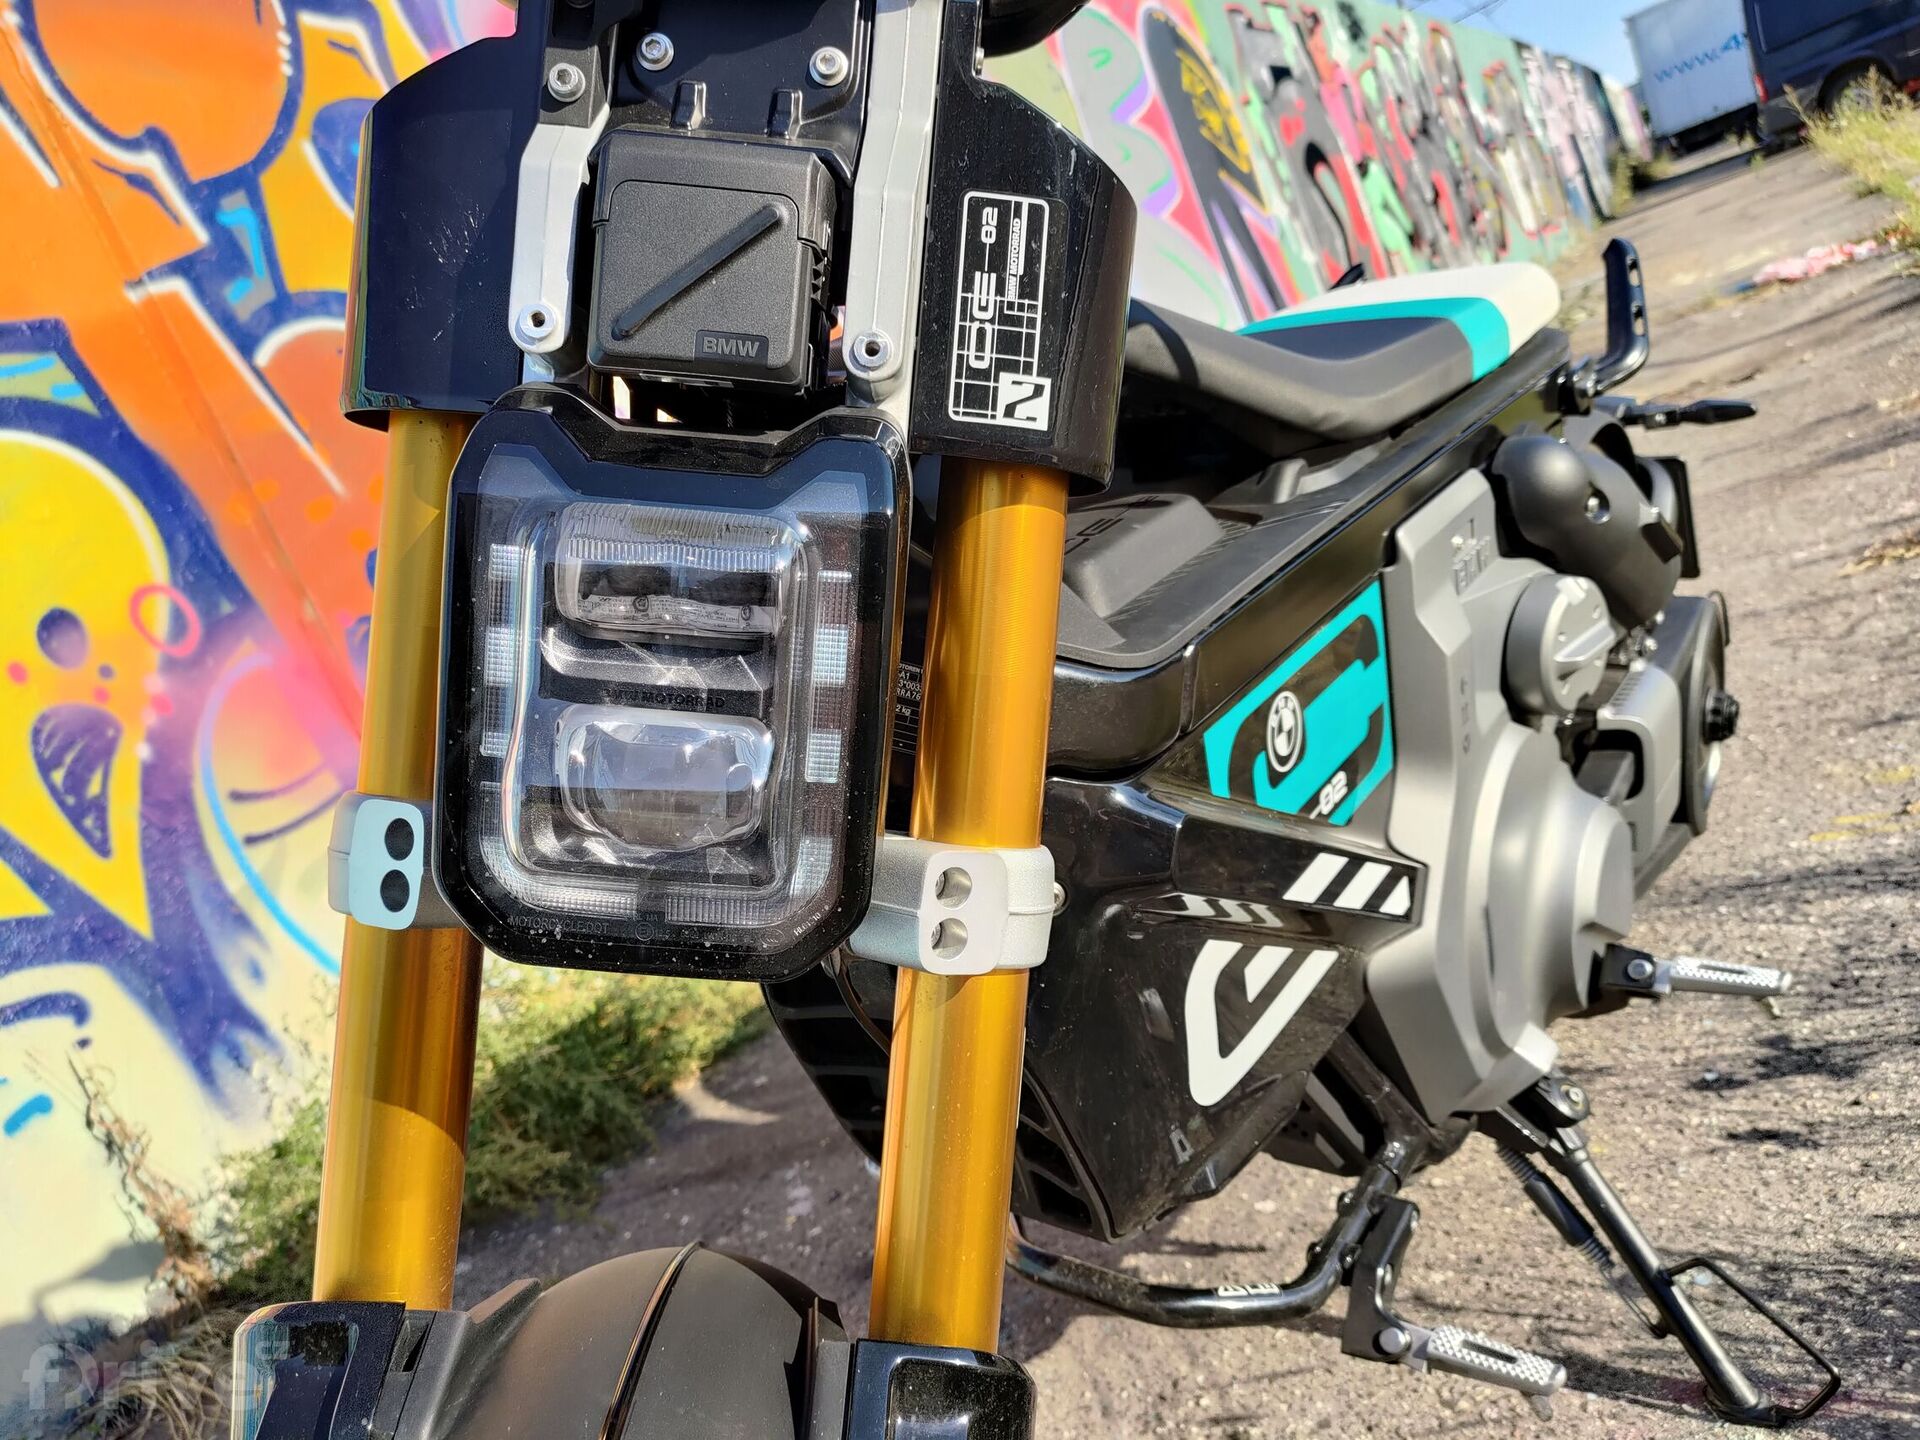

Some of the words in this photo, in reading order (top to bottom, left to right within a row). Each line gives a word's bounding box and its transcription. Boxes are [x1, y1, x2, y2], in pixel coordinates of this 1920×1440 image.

[1009, 217, 1021, 274] MOTORRAD
[702, 336, 761, 359] BMW
[640, 692, 726, 708] MOTORRAD
